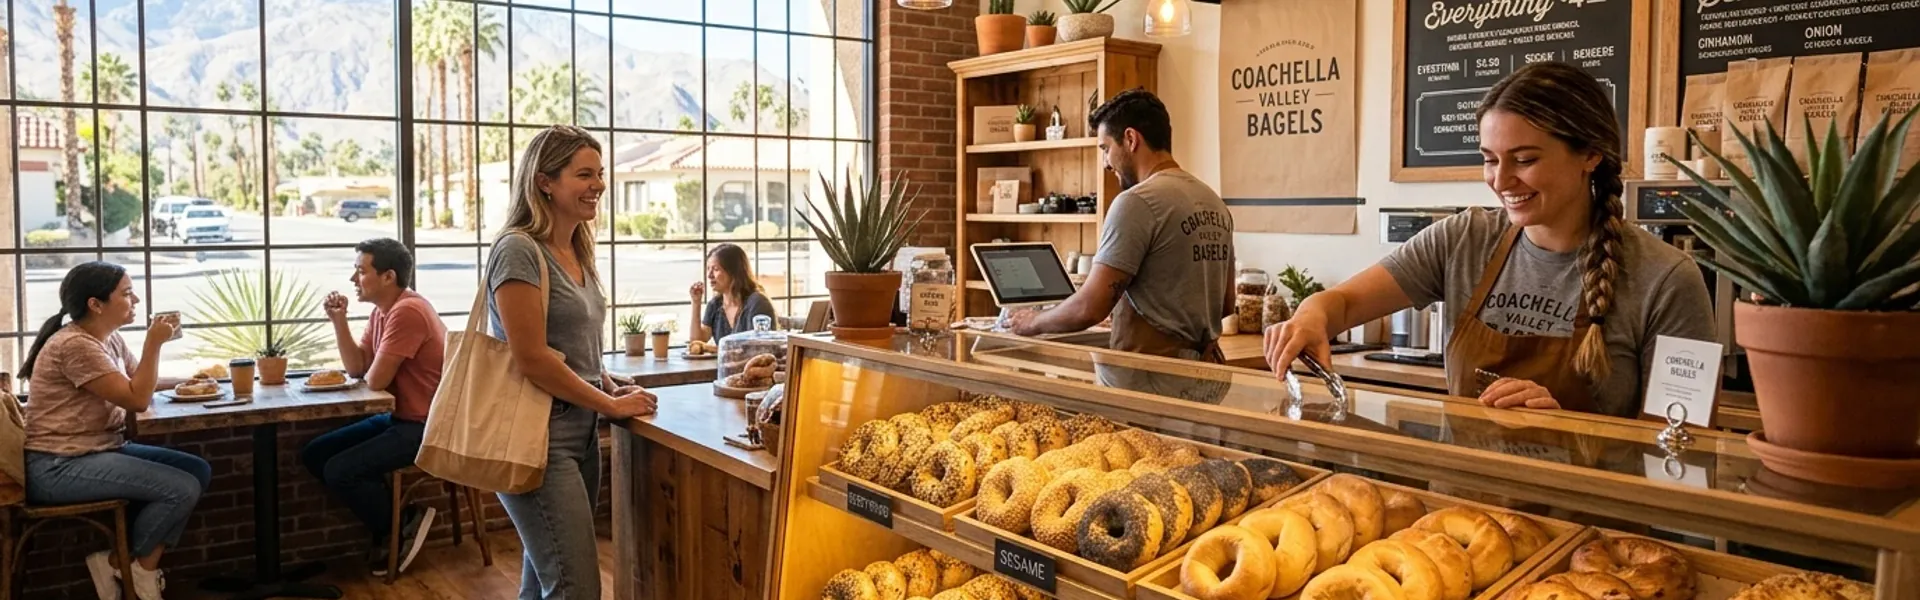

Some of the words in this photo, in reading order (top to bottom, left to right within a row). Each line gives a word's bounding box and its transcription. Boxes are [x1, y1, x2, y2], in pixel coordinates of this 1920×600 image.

[1424, 0, 1554, 30] Everything
[1231, 56, 1340, 90] COACHELLA
[1258, 88, 1310, 107] VALLEY
[1247, 108, 1323, 137] BAGELS
[1485, 292, 1575, 322] COACHELL
[1505, 312, 1555, 332] VALLEY
[1000, 549, 1045, 580] SESAME
